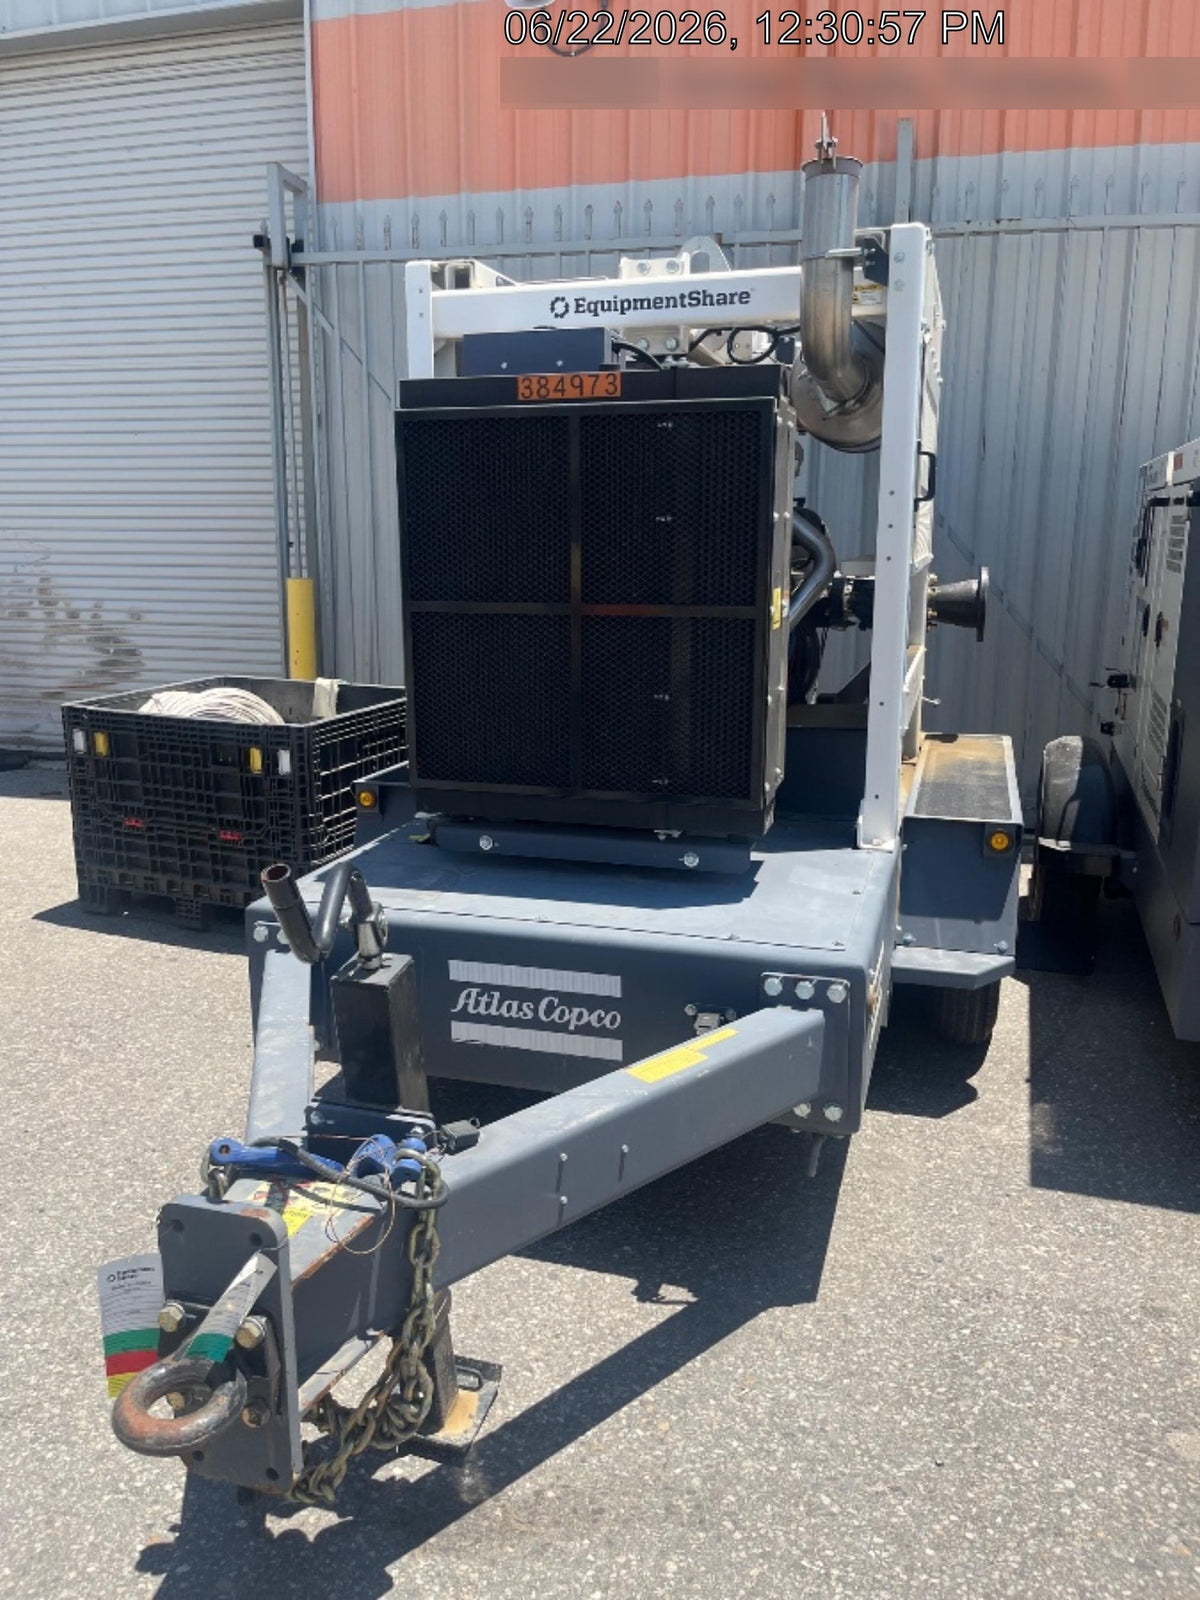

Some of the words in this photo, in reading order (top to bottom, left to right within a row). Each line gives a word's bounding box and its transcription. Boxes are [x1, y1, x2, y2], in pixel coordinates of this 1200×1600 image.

[574, 289, 751, 317] EquipmentShare
[520, 373, 619, 399] 384973
[450, 987, 535, 1020] Atlas
[537, 996, 622, 1031] Copco
